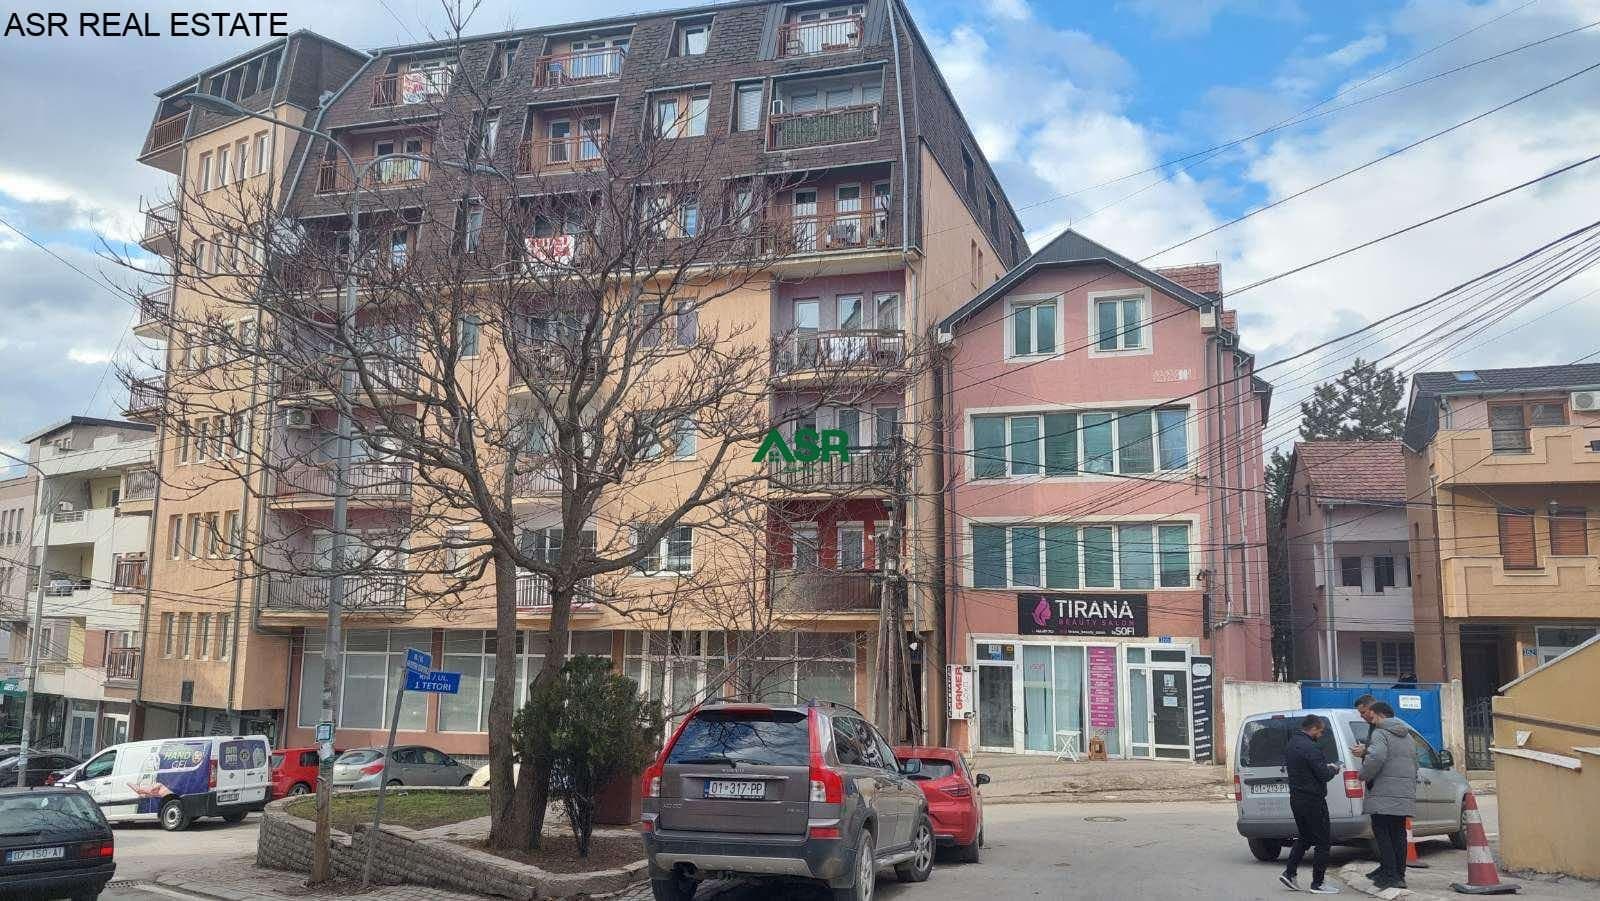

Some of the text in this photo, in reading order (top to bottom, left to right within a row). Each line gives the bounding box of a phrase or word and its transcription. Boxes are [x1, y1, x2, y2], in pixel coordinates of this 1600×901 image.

[1055, 599, 1134, 619] TIRANA
[1058, 619, 1097, 627] BEAUTY
[1116, 627, 1135, 636] SOFI
[422, 682, 451, 691] TETORI
[955, 664, 963, 710] GAMER
[164, 750, 192, 760] HAND
